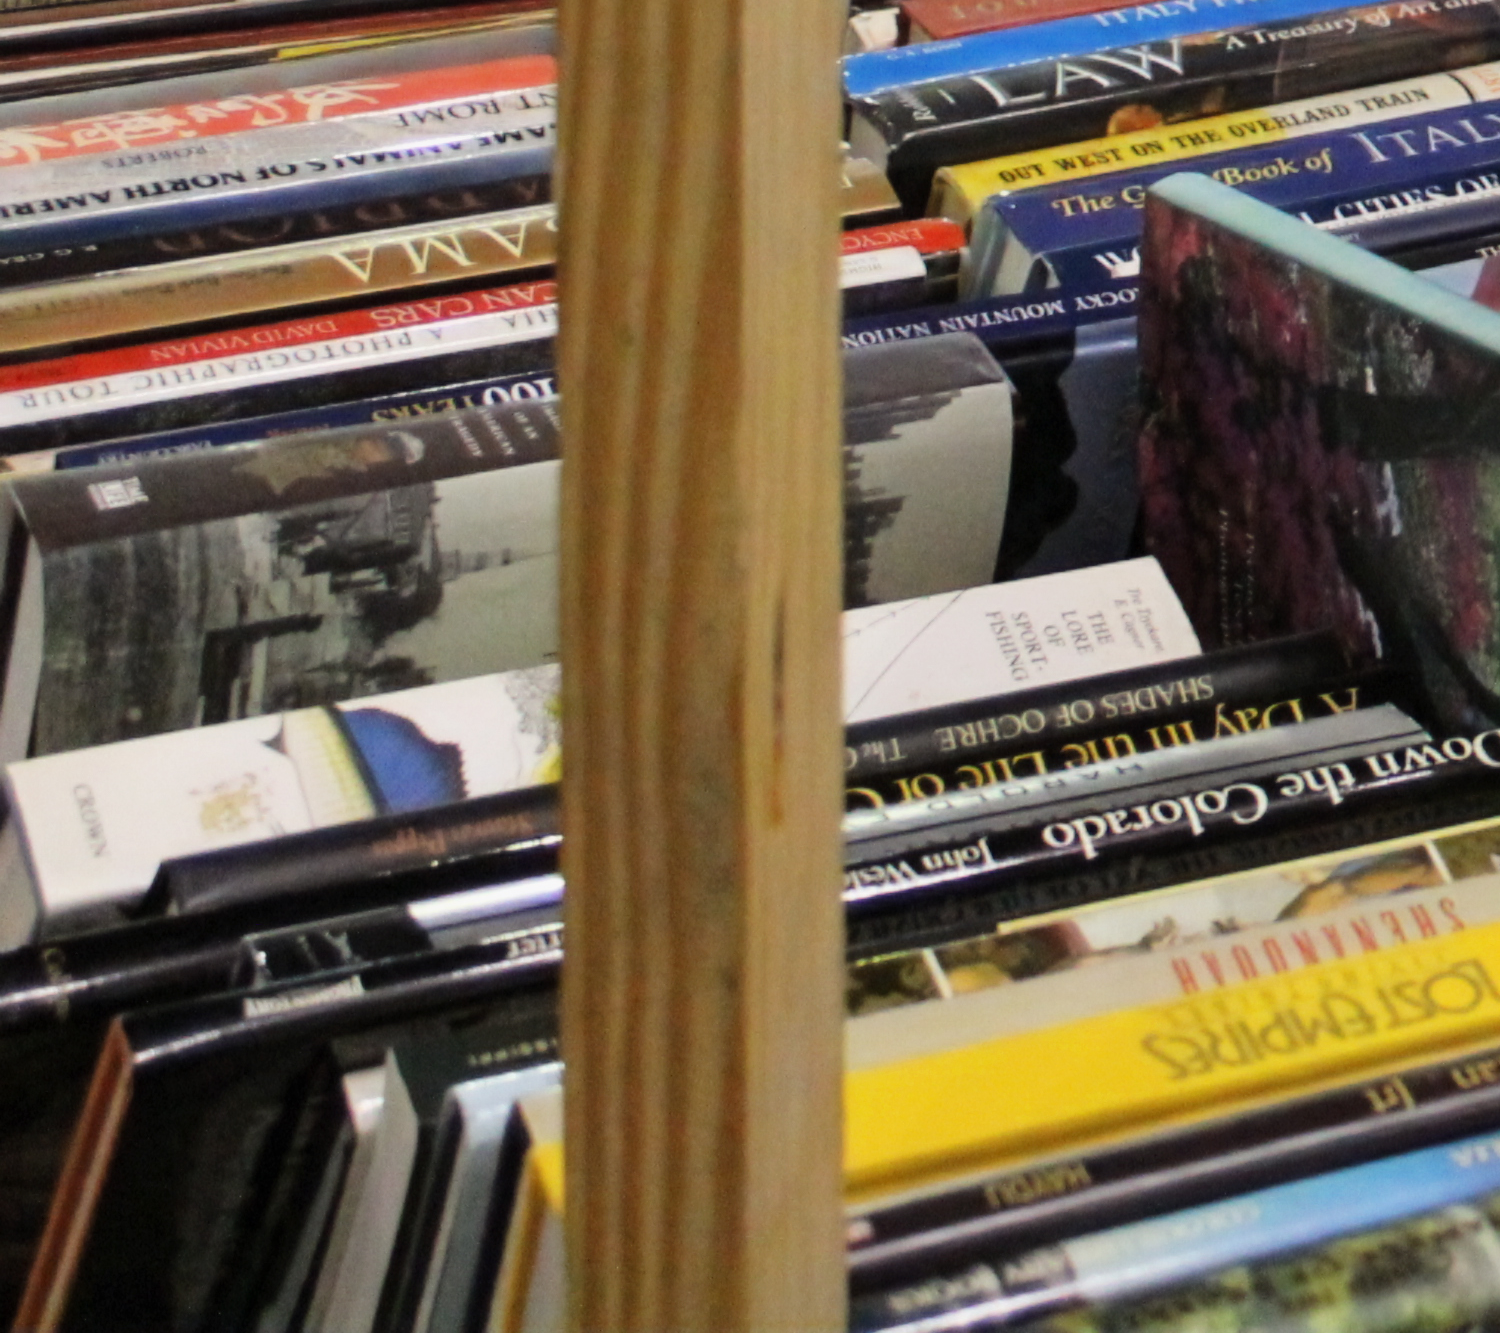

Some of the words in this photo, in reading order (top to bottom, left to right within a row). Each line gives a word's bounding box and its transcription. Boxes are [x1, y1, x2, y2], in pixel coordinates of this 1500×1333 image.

[1253, 14, 1361, 51] Treasury
[966, 35, 1184, 108] LAW
[998, 161, 1048, 185] OUT
[1052, 146, 1122, 176] WEST
[1130, 140, 1163, 158] ON
[1168, 126, 1221, 151] THE
[1228, 102, 1351, 139] OVERLAND
[1355, 87, 1430, 117] TRAIN
[123, 168, 245, 201] NORTH
[1050, 191, 1116, 219] The
[1211, 156, 1299, 188] Book
[1303, 147, 1335, 173] of
[333, 209, 557, 283] AMA
[369, 297, 476, 330] CARS
[939, 298, 1065, 336] MOUNTAIN
[1074, 287, 1140, 311] OCKY
[149, 328, 252, 362] VIVIAN
[254, 319, 340, 349] DAVID
[136, 330, 412, 391] PHOTOGRAPHIC
[22, 380, 124, 412] TOUR
[984, 610, 1030, 683] FISHING
[1010, 610, 1048, 673] SPORT-
[1043, 624, 1067, 648] OF
[1060, 609, 1096, 655] LORE
[1086, 610, 1114, 647] THE
[1055, 699, 1094, 726] OF
[1105, 674, 1215, 720] SHADES
[1318, 687, 1361, 713] A
[934, 710, 1046, 753] OCHRE
[1211, 696, 1304, 742] Day
[1274, 764, 1358, 807] the
[71, 782, 110, 859] CROWN
[1042, 781, 1271, 861] Colorado
[920, 835, 997, 873] John
[1171, 897, 1467, 995] SHENANDOAH
[1142, 990, 1370, 1082] EMPIRES
